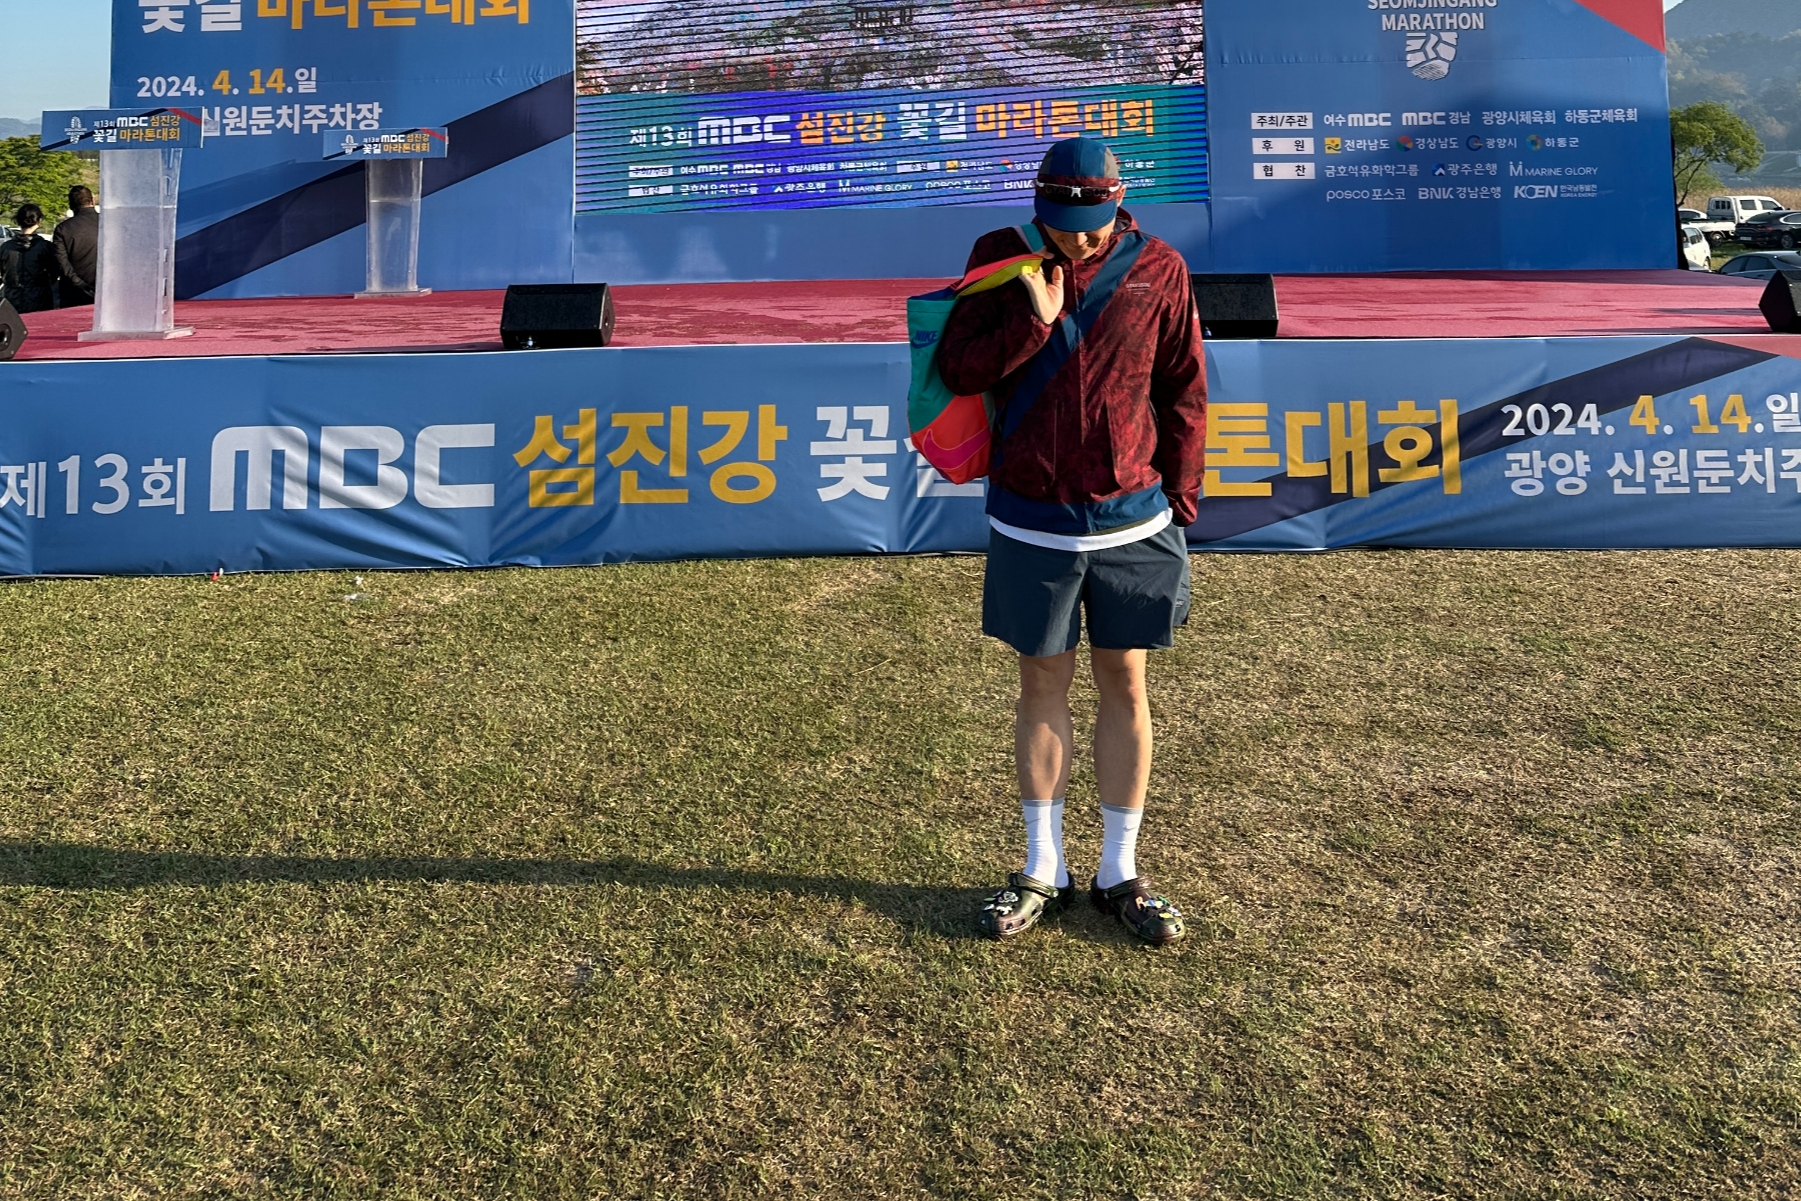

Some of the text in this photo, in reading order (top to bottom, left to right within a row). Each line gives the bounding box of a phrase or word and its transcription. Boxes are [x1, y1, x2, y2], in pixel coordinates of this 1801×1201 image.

[1382, 12, 1484, 30] MARATHON
[136, 76, 204, 97] 2024.
[212, 70, 239, 95] 4.
[116, 116, 148, 127] MBC
[150, 115, 181, 127] 섬진강
[629, 99, 1154, 147] 제13회 MBC 섬진강 꽃길 마라톤대회
[1256, 115, 1308, 127] 주최/주관
[1482, 110, 1556, 125] 광양시체육회
[1565, 108, 1638, 124] 하동군체육회
[92, 129, 117, 143] 꽃길
[119, 128, 180, 142] 마라톤대회
[380, 134, 405, 143] MBC
[1344, 139, 1390, 151] 전라남도
[1415, 137, 1459, 150] 경상남도
[1486, 137, 1517, 149] 광양시
[1545, 137, 1579, 148] 하동군
[1324, 164, 1419, 178] 금호석유화학그룹
[1448, 163, 1498, 176] 광주은행
[1525, 167, 1562, 176] MARINE
[1565, 167, 1598, 176] GLORY
[915, 330, 939, 341] NIKE
[1501, 402, 1615, 437] 2024.
[1629, 394, 1673, 436] 4.
[0, 453, 187, 519] 제13회
[209, 423, 496, 512] MBC
[513, 404, 788, 508] 섬진강
[1504, 449, 1592, 496] 광양
